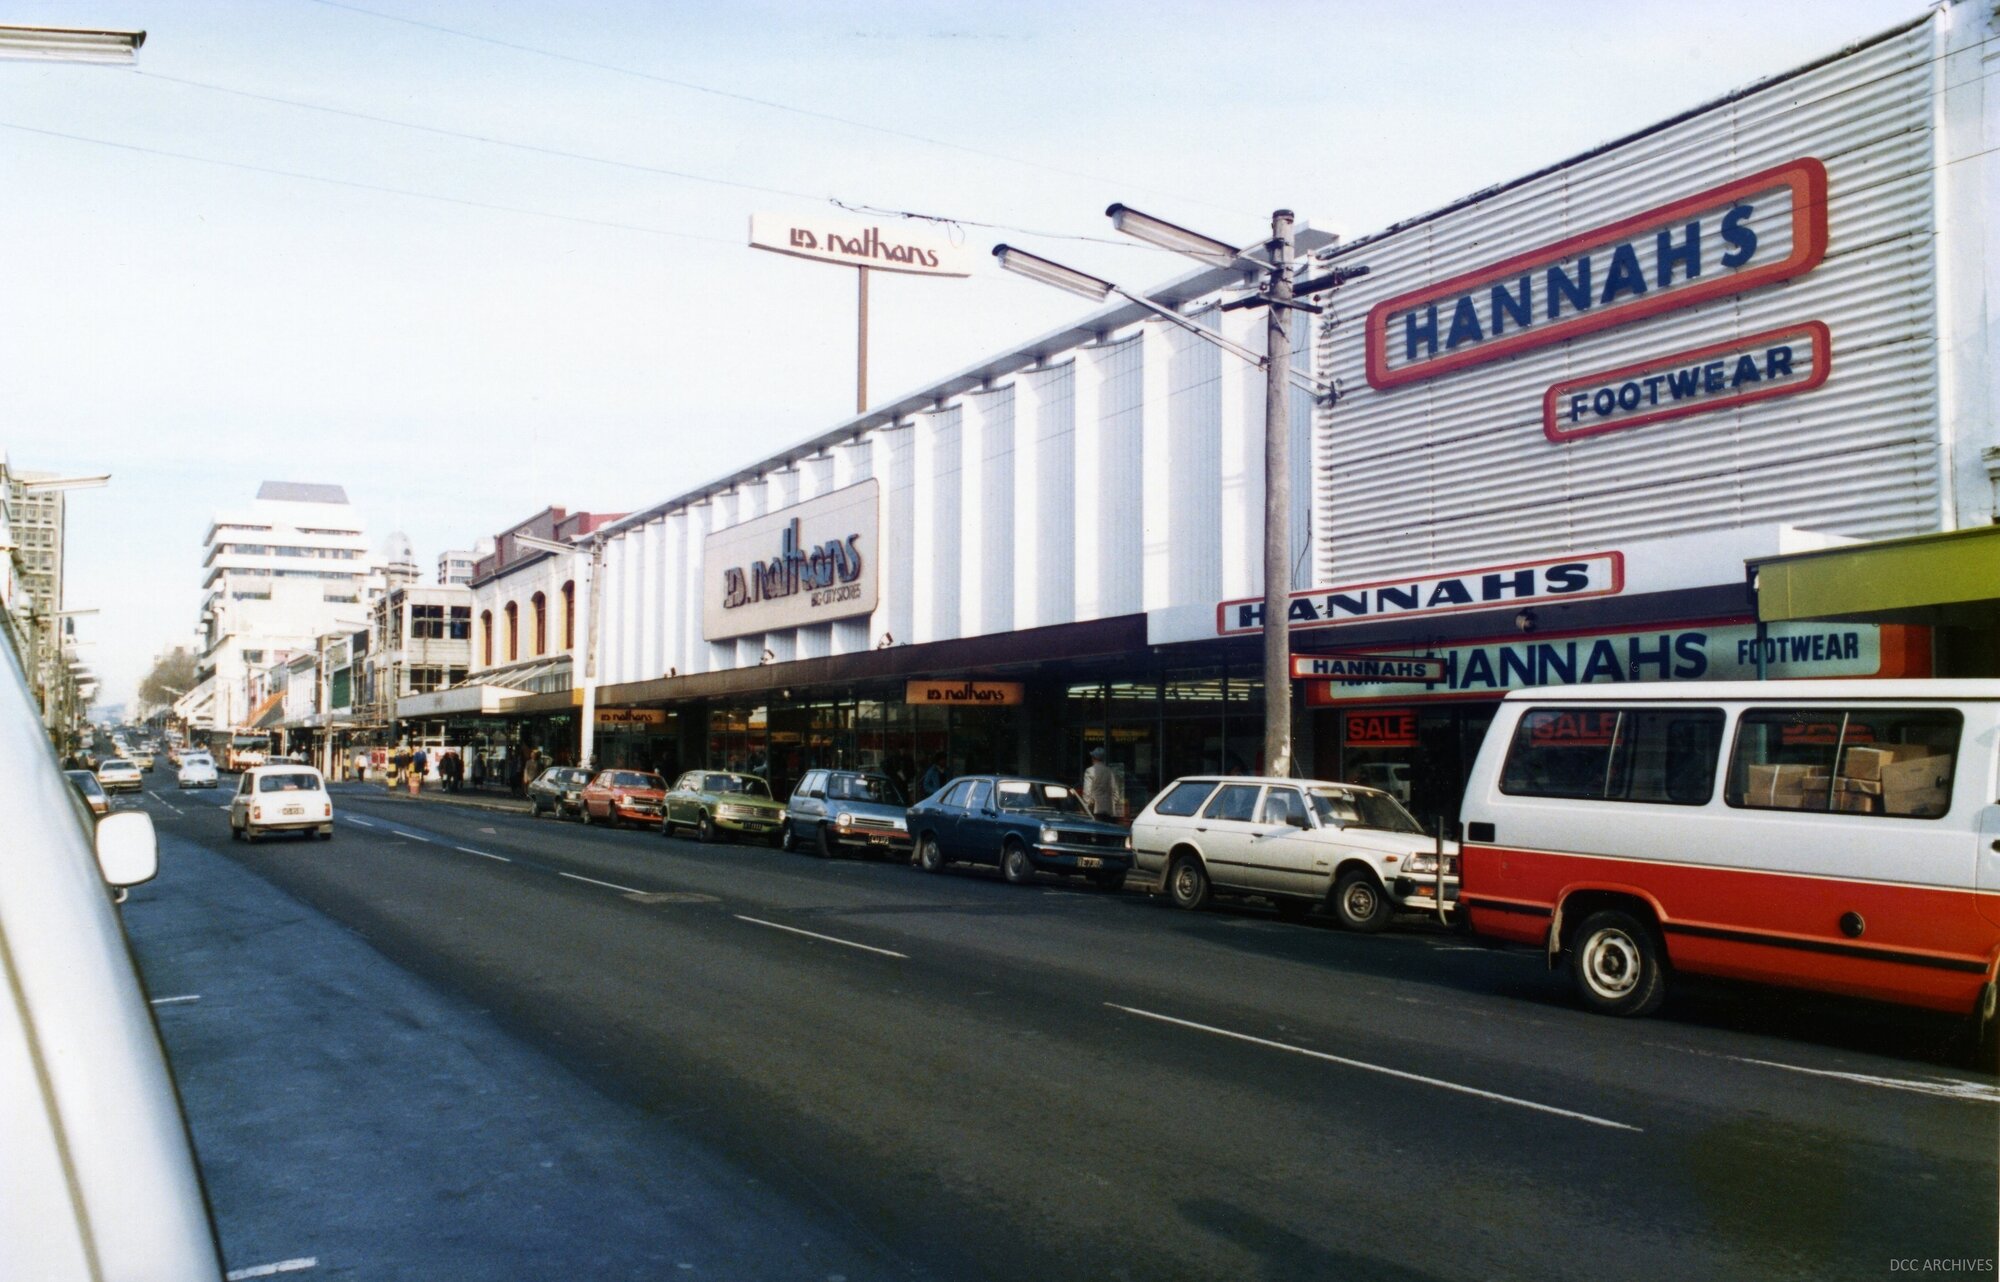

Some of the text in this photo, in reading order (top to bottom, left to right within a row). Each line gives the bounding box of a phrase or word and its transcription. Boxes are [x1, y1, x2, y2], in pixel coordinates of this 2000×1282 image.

[827, 226, 939, 268] nathans
[1406, 205, 1758, 360] HANNAHS
[1570, 345, 1794, 422] FOOTWEAR
[752, 516, 862, 604] nathans
[1238, 563, 1590, 628] HANNAHS
[1313, 659, 1427, 677] HANNAHS
[1425, 631, 1859, 691] HANNAHS FOOTWEAR
[945, 681, 1005, 701] nathans
[613, 708, 653, 721] nathans
[1349, 718, 1417, 740] SALE
[1532, 711, 1617, 739] SALE
